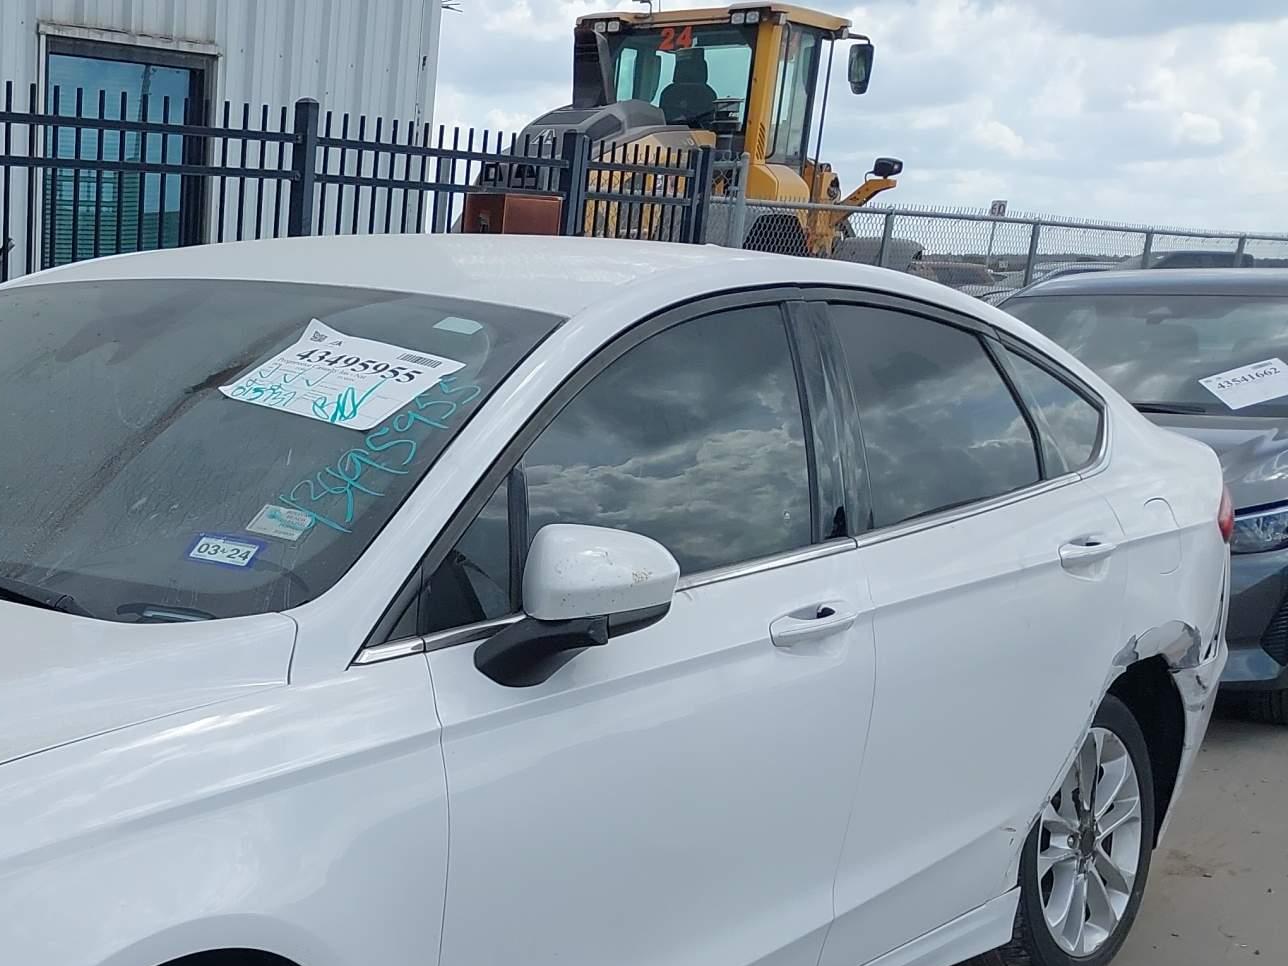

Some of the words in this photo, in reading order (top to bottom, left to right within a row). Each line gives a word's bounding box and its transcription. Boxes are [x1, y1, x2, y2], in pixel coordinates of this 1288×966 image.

[659, 26, 693, 51] 24
[295, 348, 424, 383] 43495955
[1217, 367, 1281, 390] 43541662
[197, 543, 220, 556] 03
[226, 548, 252, 561] 24
